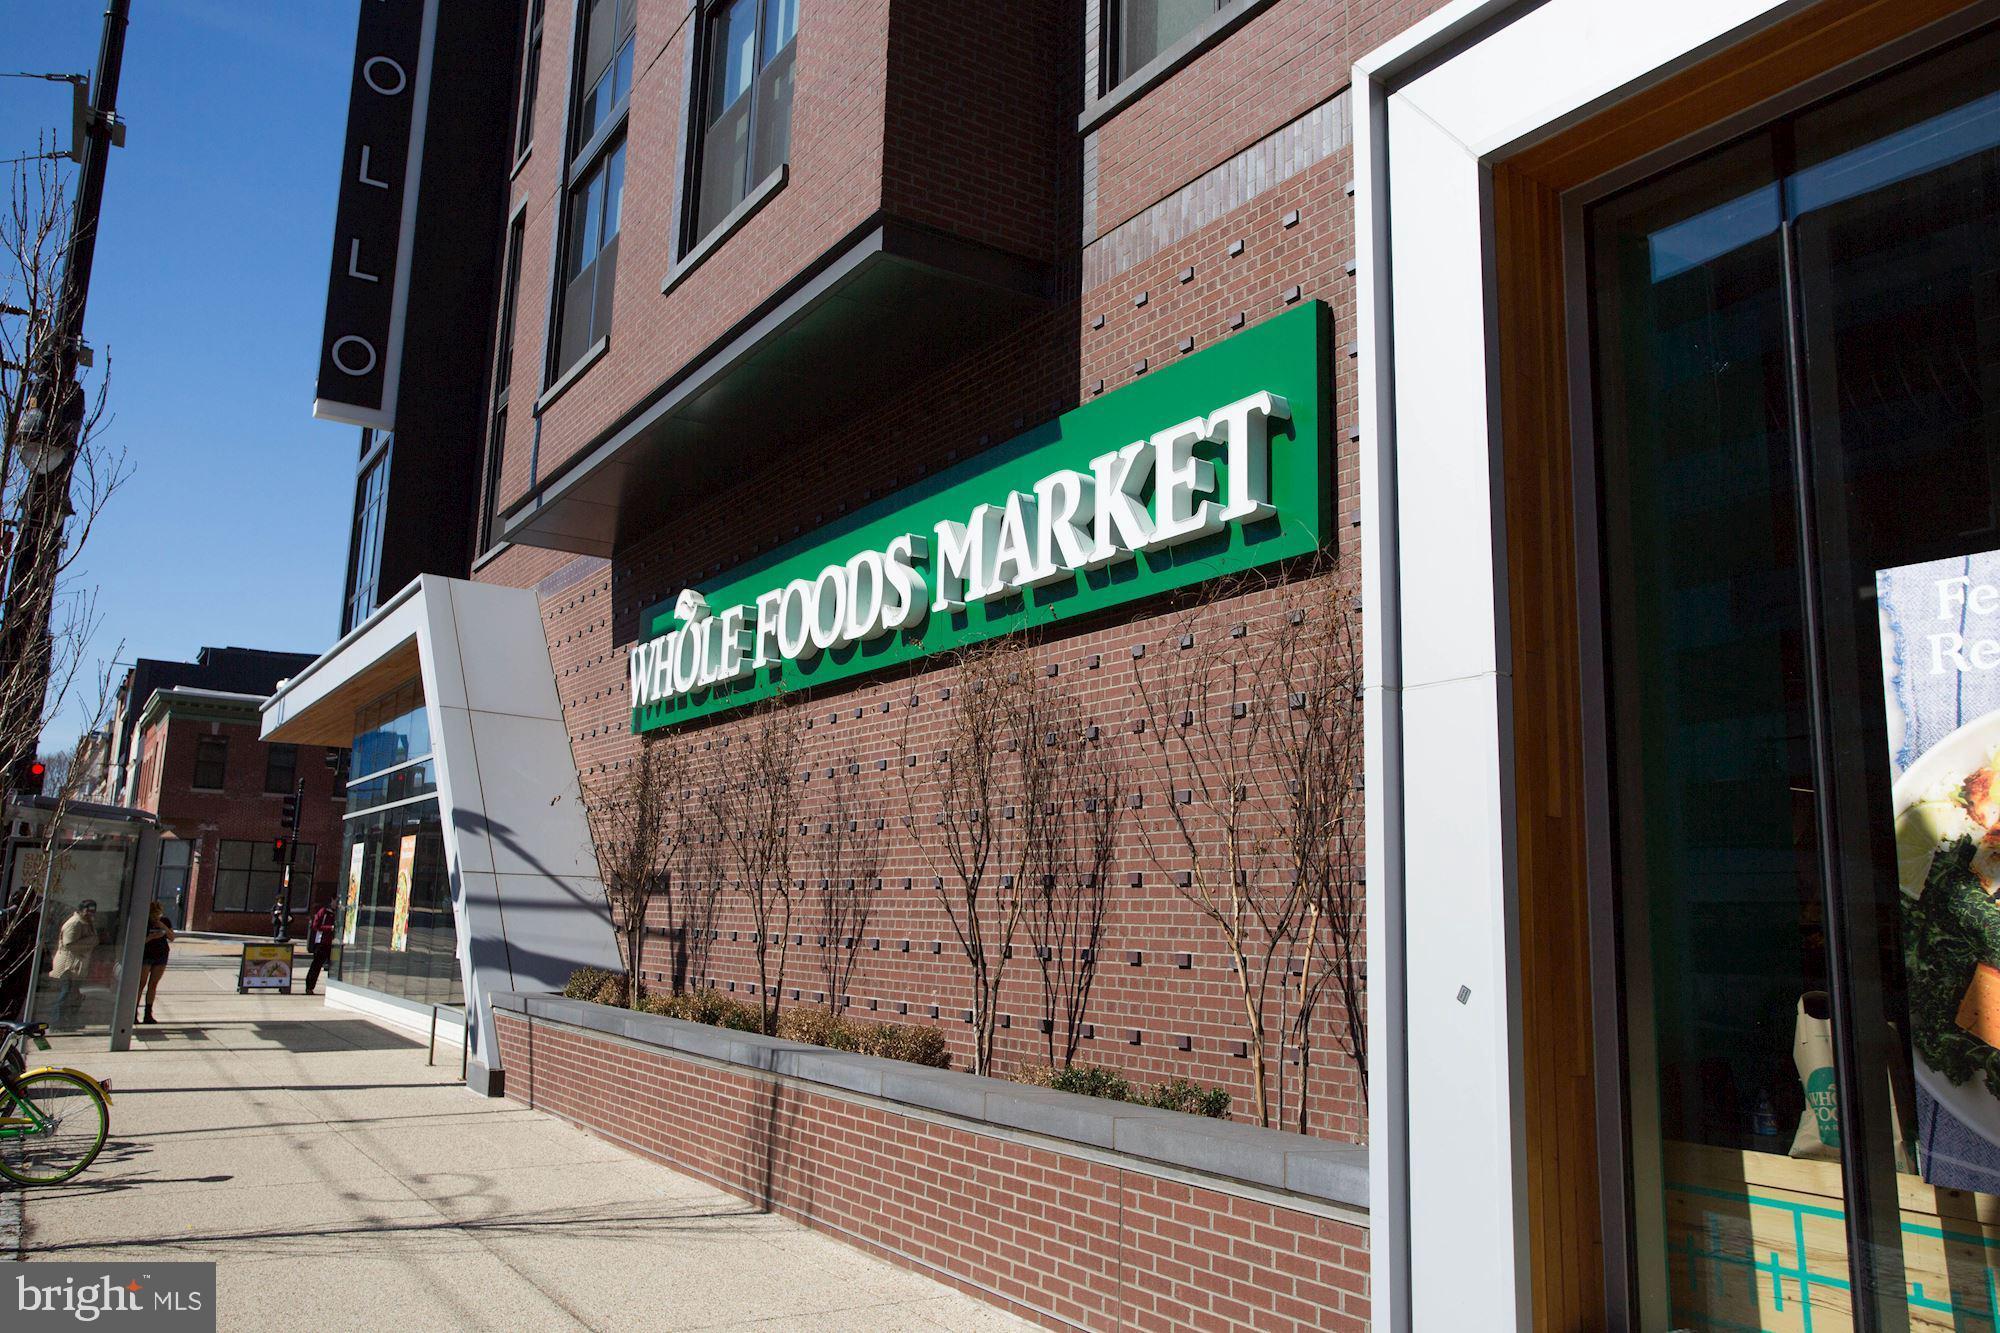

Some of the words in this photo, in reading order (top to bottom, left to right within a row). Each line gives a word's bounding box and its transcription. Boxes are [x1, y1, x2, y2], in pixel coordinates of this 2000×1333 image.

[332, 0, 406, 376] OLLO
[629, 589, 755, 708] WHOLE
[752, 534, 926, 669] FOODS
[931, 391, 1287, 613] MARKET
[1935, 575, 2000, 619] Fe
[1927, 632, 2000, 674] Re
